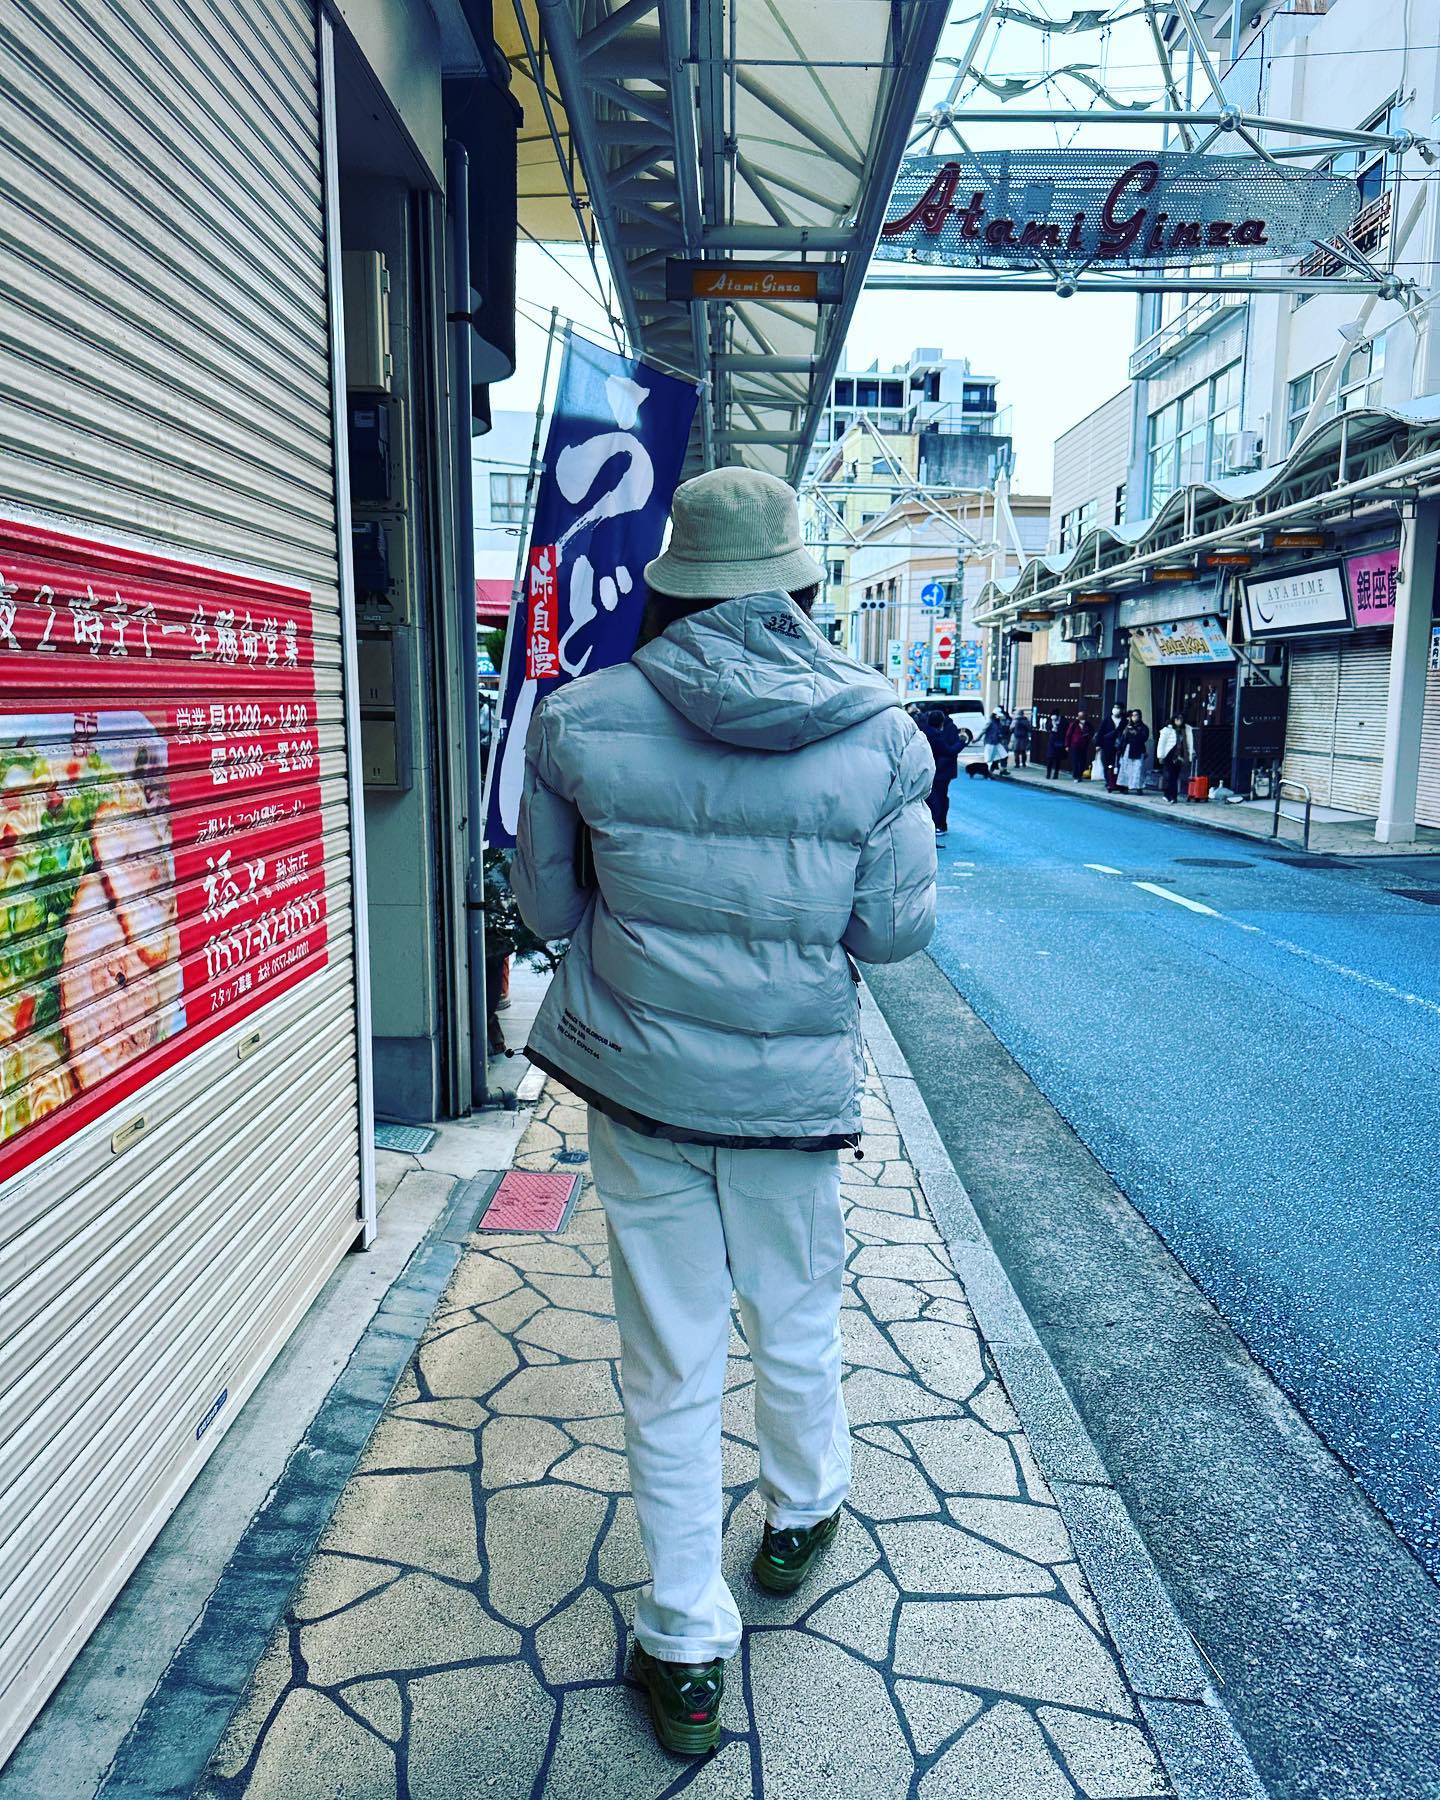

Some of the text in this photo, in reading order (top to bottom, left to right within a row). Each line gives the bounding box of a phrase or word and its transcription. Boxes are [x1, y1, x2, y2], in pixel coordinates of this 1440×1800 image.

[882, 160, 1268, 255] Atami Ginza
[708, 273, 801, 292] Atami Ginza
[1268, 578, 1325, 601] AYAHIME
[530, 558, 559, 678] 味自慢
[210, 973, 252, 1011] スタッフ募集
